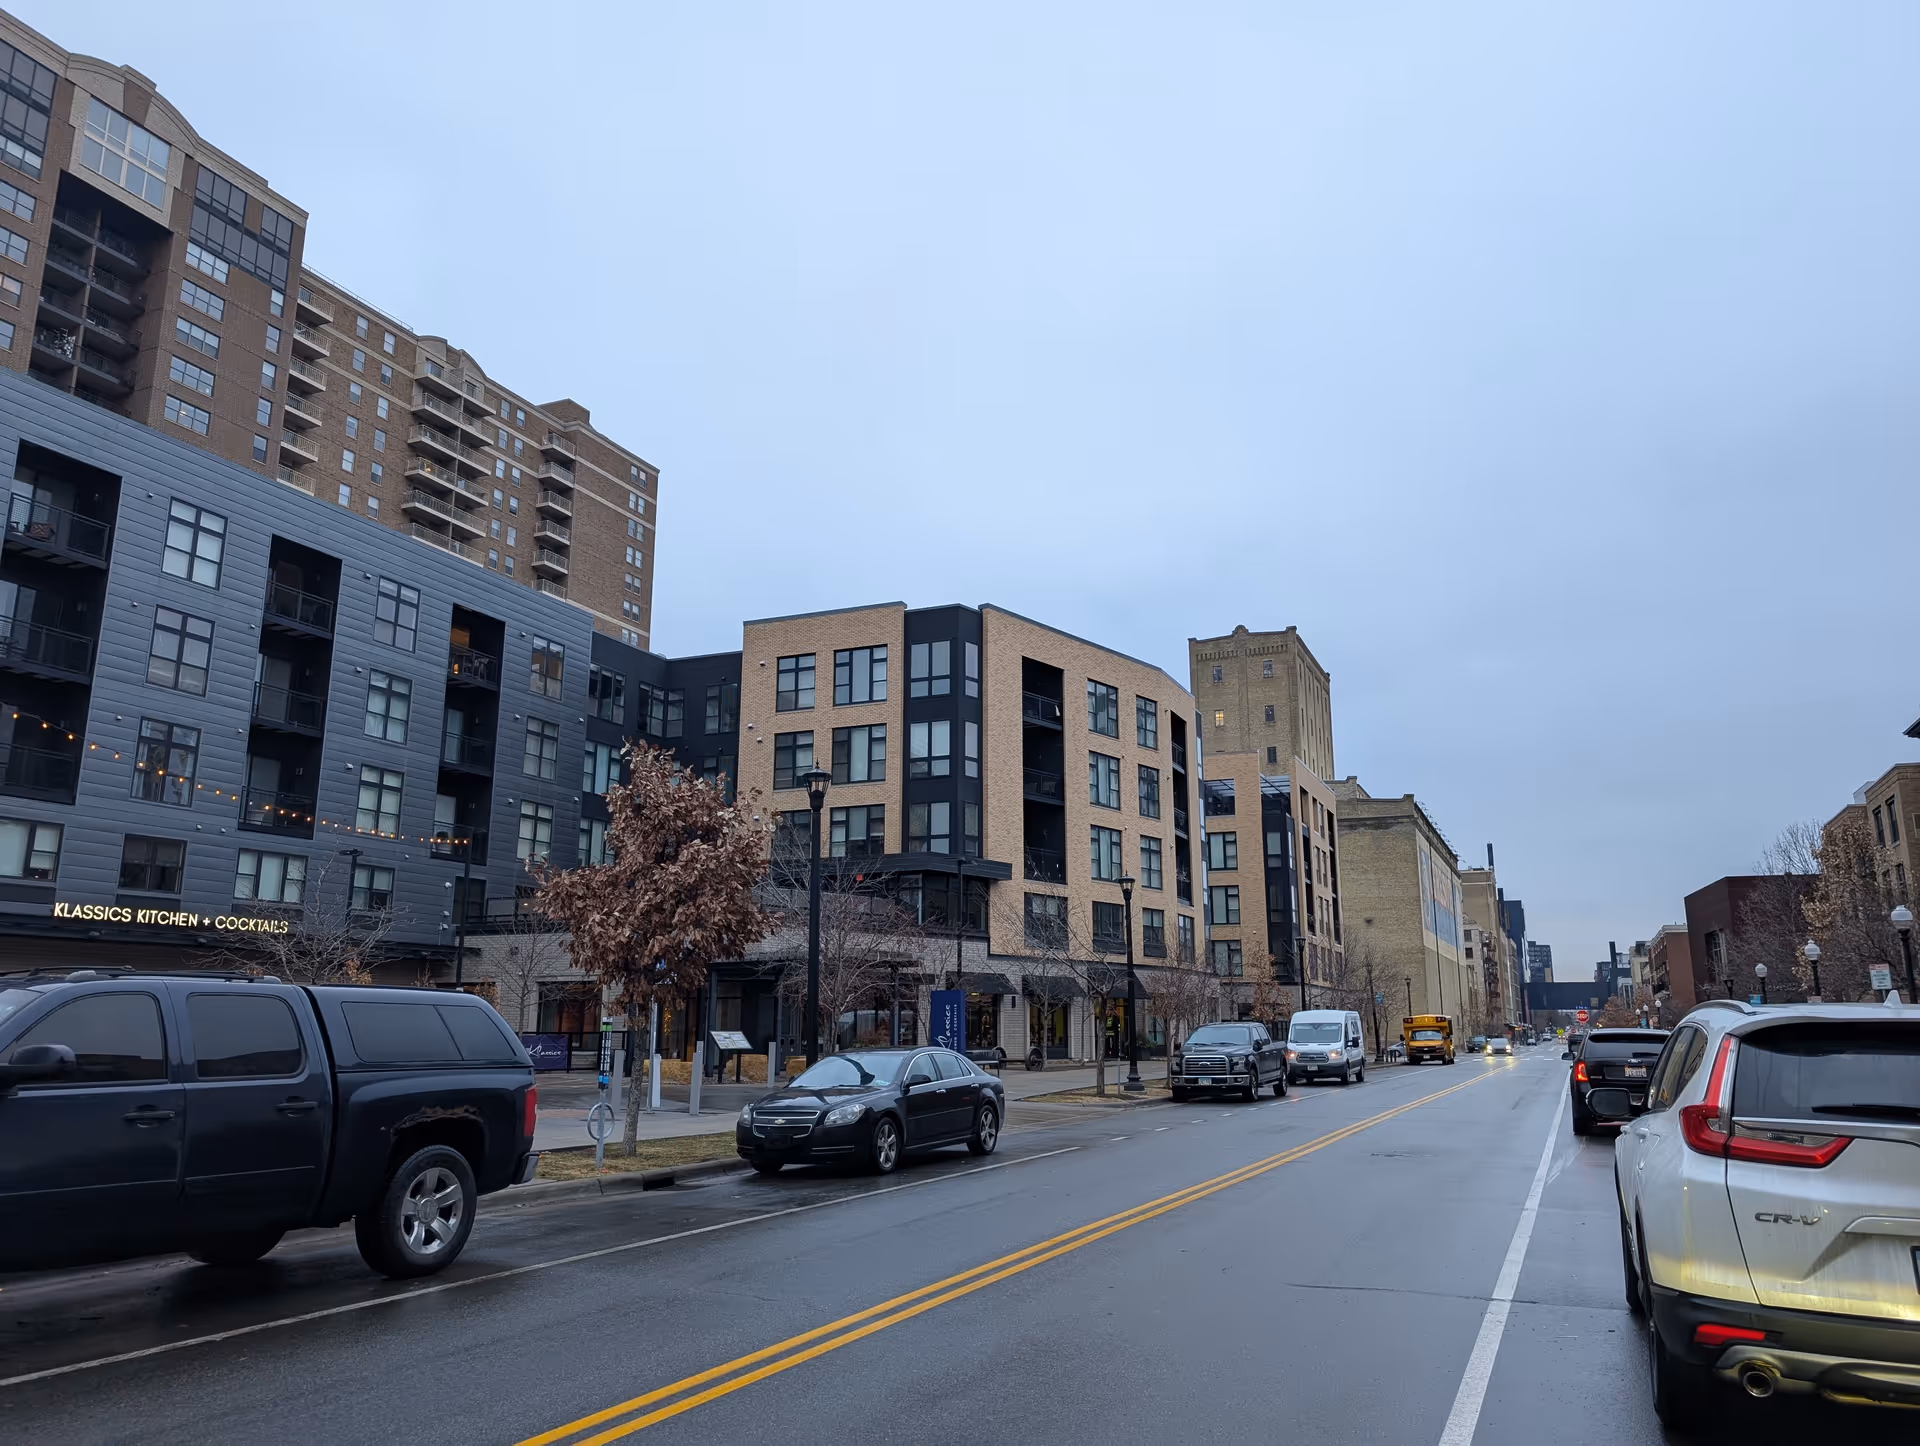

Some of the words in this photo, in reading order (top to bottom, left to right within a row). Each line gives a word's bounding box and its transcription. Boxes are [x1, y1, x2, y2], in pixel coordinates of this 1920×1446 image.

[54, 902, 132, 922] KLASSICS
[136, 909, 198, 927] KITCHEN
[203, 917, 210, 926] +
[215, 915, 289, 934] COCKTAILS
[1754, 1212, 1820, 1225] CR-V
